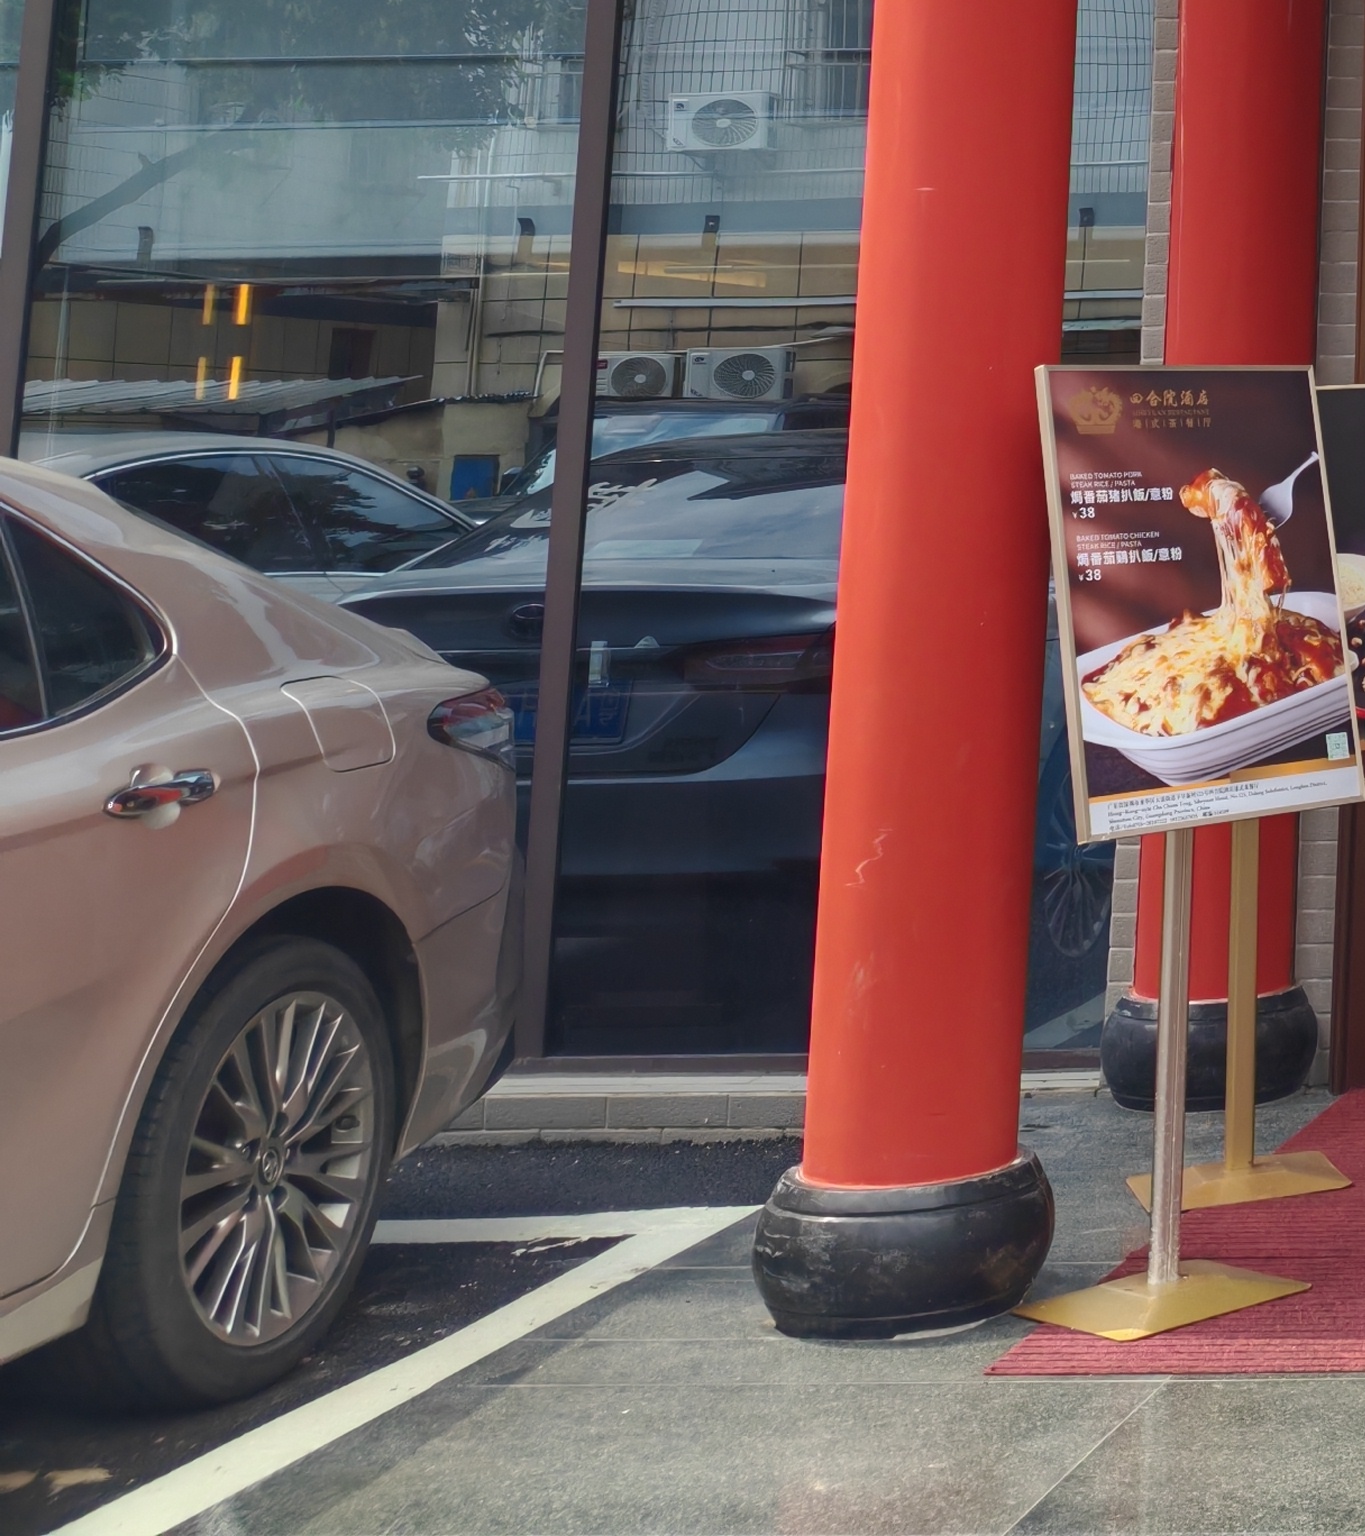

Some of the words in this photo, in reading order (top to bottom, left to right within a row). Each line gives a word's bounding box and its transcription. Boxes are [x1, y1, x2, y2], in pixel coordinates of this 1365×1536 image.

[1094, 472, 1122, 480] TOMATO
[1076, 534, 1099, 542] BAKED
[1100, 533, 1129, 541] TOMATO
[1129, 531, 1160, 539] CHICKEN
